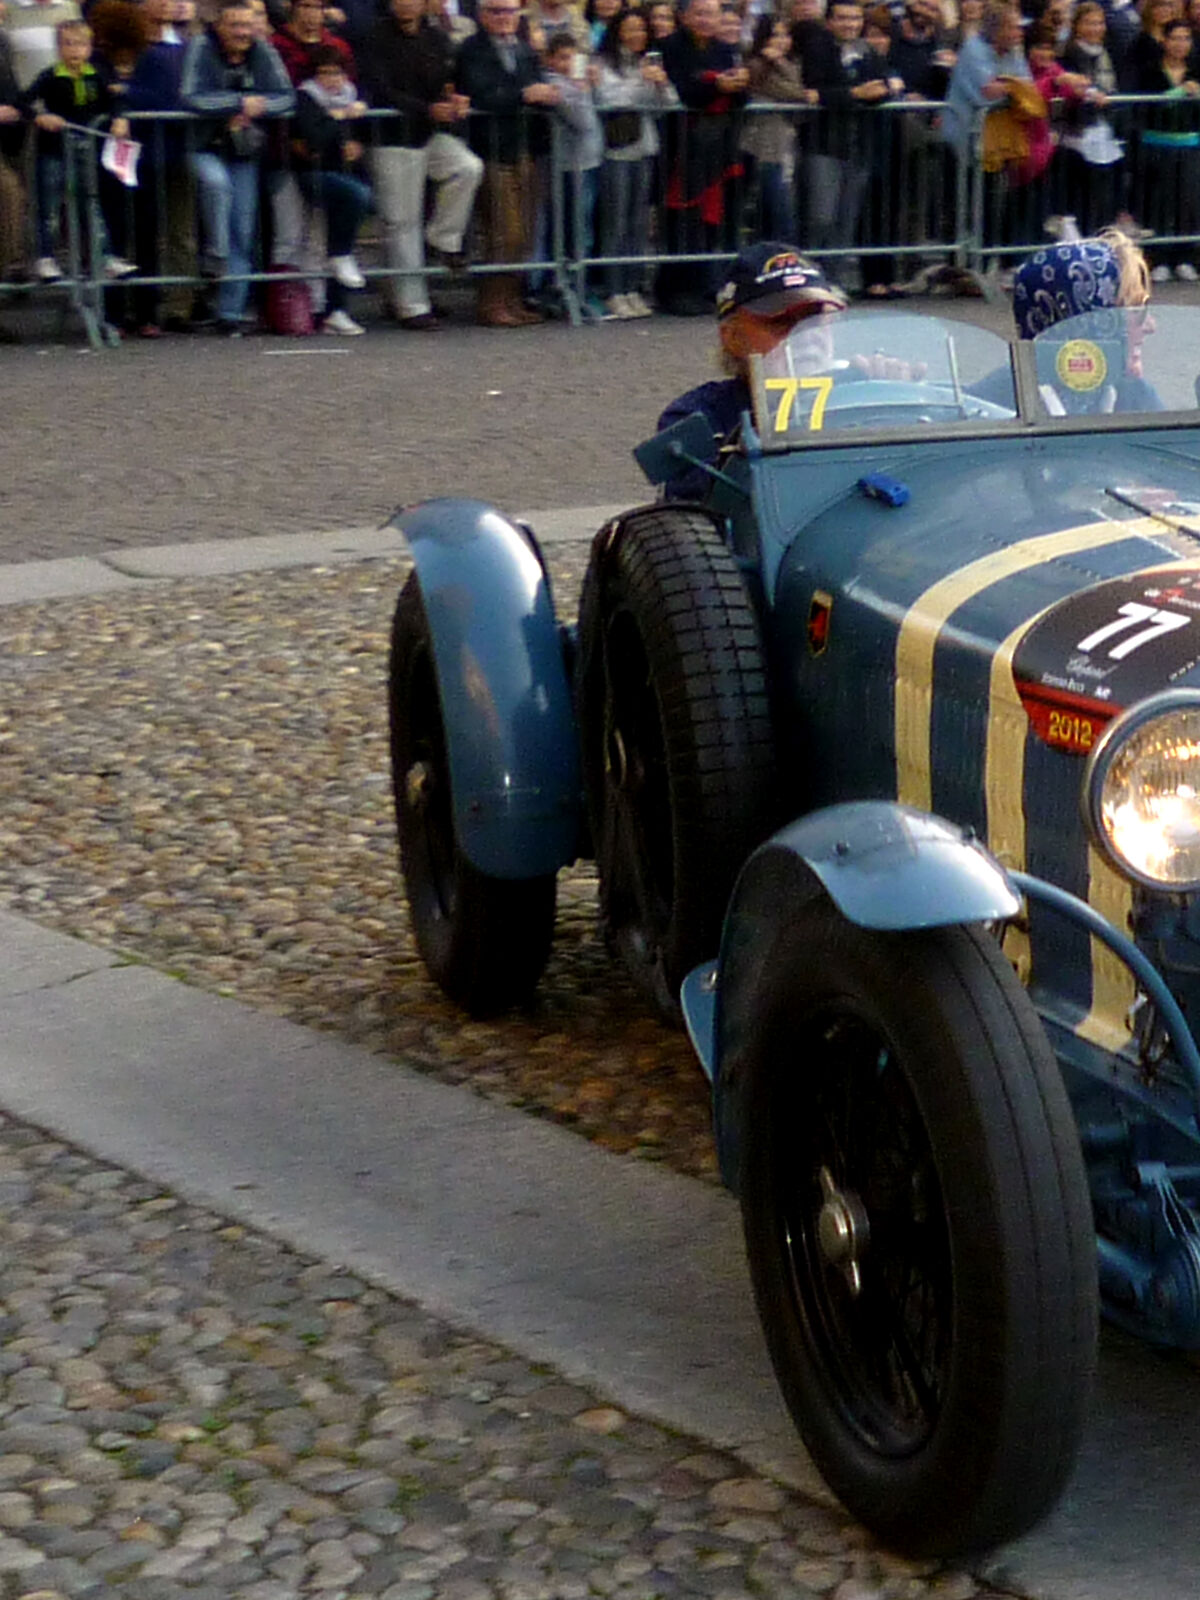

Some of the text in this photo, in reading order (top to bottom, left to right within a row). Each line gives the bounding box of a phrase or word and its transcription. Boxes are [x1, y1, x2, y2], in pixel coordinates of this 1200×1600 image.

[765, 377, 834, 433] 77
[1077, 602, 1191, 660] 77
[1049, 711, 1092, 747] 2012
